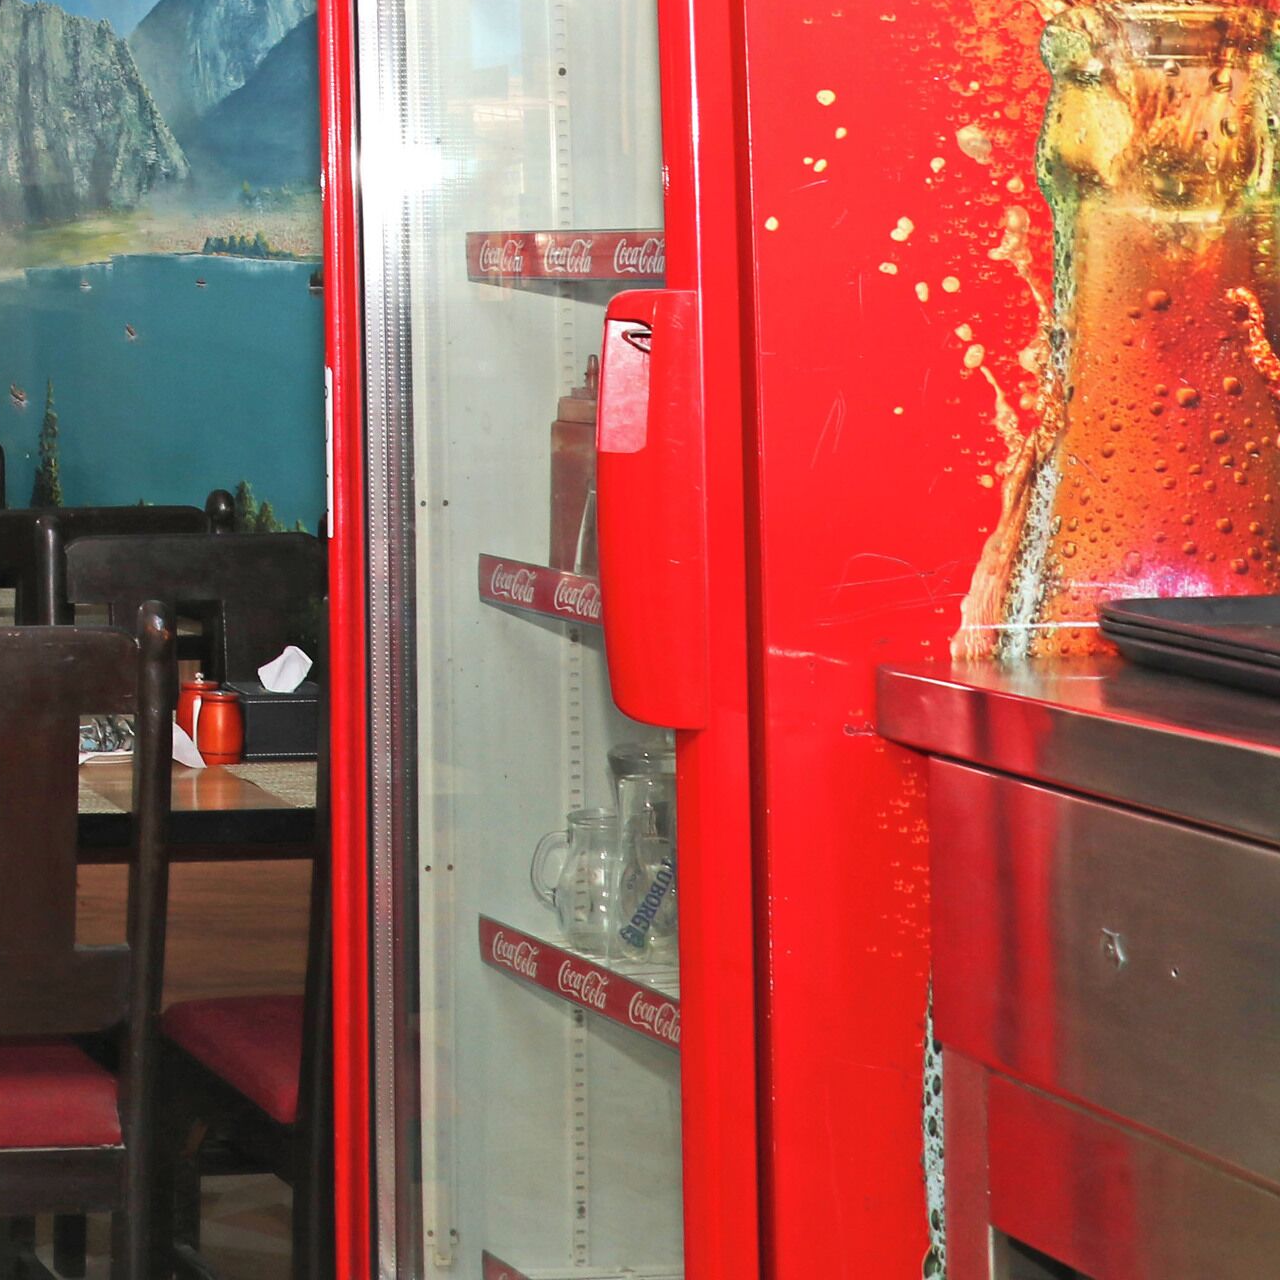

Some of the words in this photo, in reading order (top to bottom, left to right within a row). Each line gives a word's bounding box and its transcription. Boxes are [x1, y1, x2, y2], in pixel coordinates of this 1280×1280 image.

[479, 238, 524, 272] Coca-Cola
[544, 238, 592, 273] Coca-Cola
[613, 238, 665, 273] Coca-Cola
[491, 563, 536, 603] Coca-Cola
[554, 577, 601, 618] Coca-Cola
[493, 931, 538, 978] Coca-Cola
[558, 960, 608, 1009] Coca-Cola
[629, 992, 680, 1042] Coca-Cola
